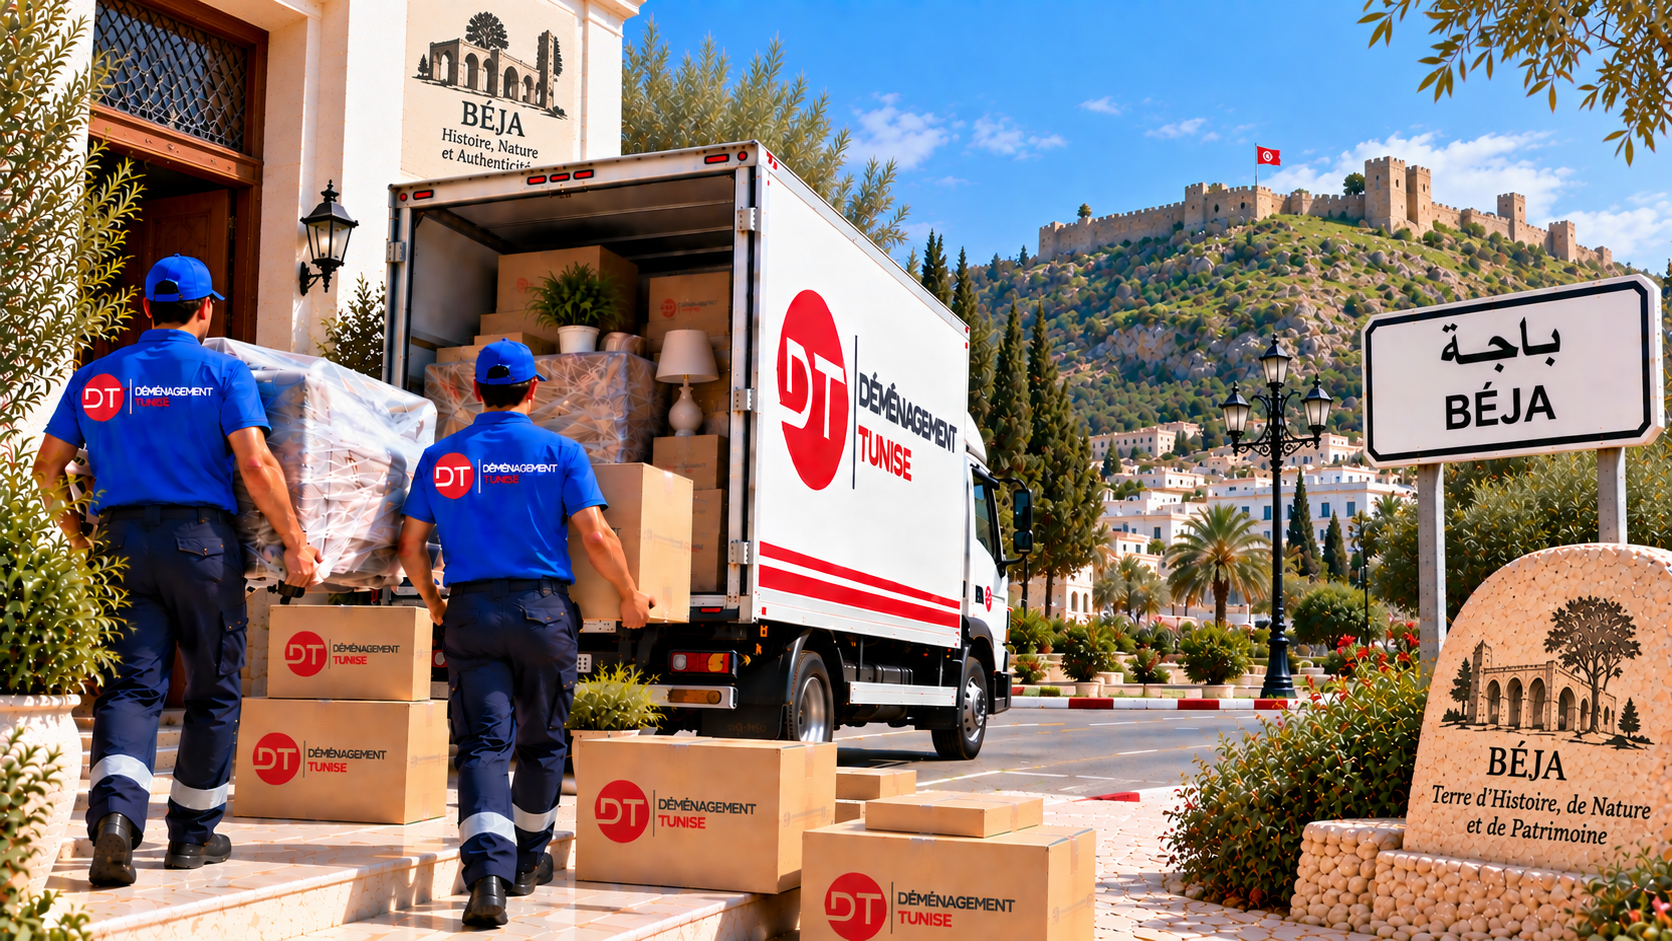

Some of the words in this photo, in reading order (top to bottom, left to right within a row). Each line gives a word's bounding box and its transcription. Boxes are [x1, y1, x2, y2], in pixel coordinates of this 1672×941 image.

[461, 99, 525, 137] BÉJA
[442, 127, 494, 152] Histoire,
[498, 139, 538, 159] Nature
[442, 148, 454, 160] et
[1441, 316, 1561, 373] باجة
[83, 388, 121, 409] DT
[135, 385, 213, 396] DÉMÉNAGEMENT
[779, 336, 846, 440] DT
[859, 372, 957, 453] DÉMÉNAGEMENT
[1445, 381, 1557, 430] BÉJA
[858, 424, 912, 482] TUNISE
[435, 466, 471, 487] DT
[483, 462, 558, 473] DÉMÉNAGEMENT
[285, 644, 324, 665] DT
[333, 643, 400, 653] DÉMÉNAGEMENT
[332, 655, 367, 665] TUNISE
[253, 747, 297, 770] DT
[308, 746, 387, 760] DÉMÉNAGEMENT
[1486, 740, 1567, 781] BÉJA
[308, 762, 347, 773] TUNISE
[596, 797, 645, 827] DT
[658, 796, 757, 815] DÉMÉNAGEMENT
[1432, 784, 1472, 806] Terre
[1566, 794, 1587, 815] de
[1591, 796, 1651, 820] Nature
[658, 814, 706, 830] TUNISE
[1466, 817, 1482, 834] et
[1487, 816, 1506, 836] de
[1510, 818, 1607, 845] Patrimoine
[827, 890, 882, 925] DT
[898, 889, 1016, 913] DÉMÉNAGEMENT
[897, 910, 953, 928] TUNISE
